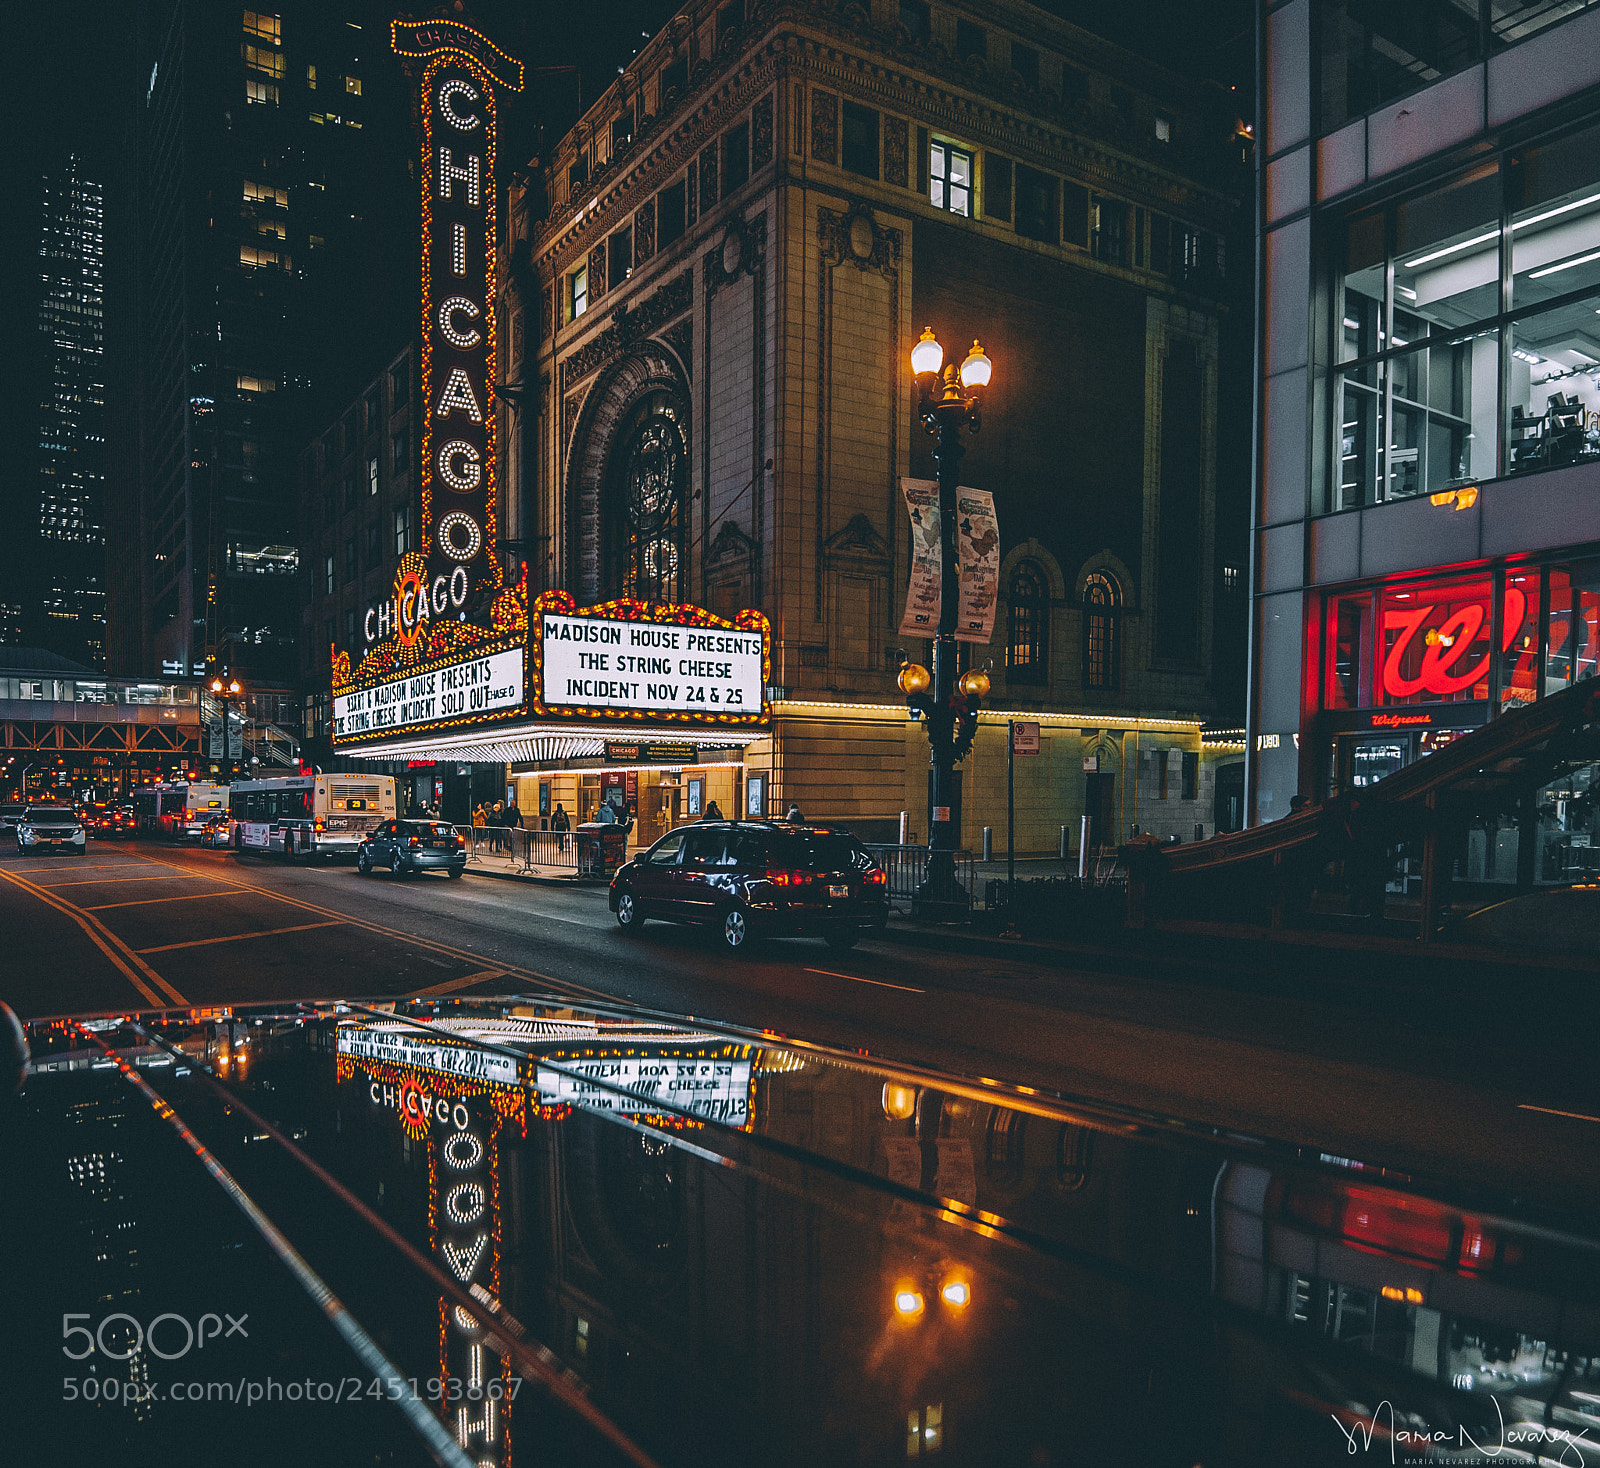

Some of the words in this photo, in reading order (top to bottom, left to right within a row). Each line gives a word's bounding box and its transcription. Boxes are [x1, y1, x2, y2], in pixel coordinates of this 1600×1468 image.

[415, 29, 481, 56] CHASE
[437, 79, 482, 561] CHICAGO
[973, 574, 986, 584] Day
[364, 565, 469, 643] CHICAGO
[545, 622, 621, 644] MADISON
[630, 629, 680, 650] HOUSE
[687, 633, 761, 655] PRESENTS
[578, 652, 609, 671] THE
[616, 655, 672, 675] STRING
[679, 659, 733, 679] CHEESE
[375, 681, 407, 707] MADISON
[410, 674, 436, 700] HOUSE
[441, 659, 492, 692] PRESENTS
[487, 687, 509, 701] CHASE
[566, 678, 640, 700] INCIDENT
[647, 684, 679, 701] NOV
[686, 686, 705, 703] 24
[709, 687, 721, 703] &
[726, 688, 743, 705] 25
[334, 717, 345, 735] THE
[348, 712, 370, 731] STRING
[372, 705, 397, 727] CHEESE
[401, 698, 436, 722] INCIDENT
[441, 691, 465, 715] SOLD
[470, 685, 490, 708] OUT
[1371, 714, 1432, 728] Walgreens
